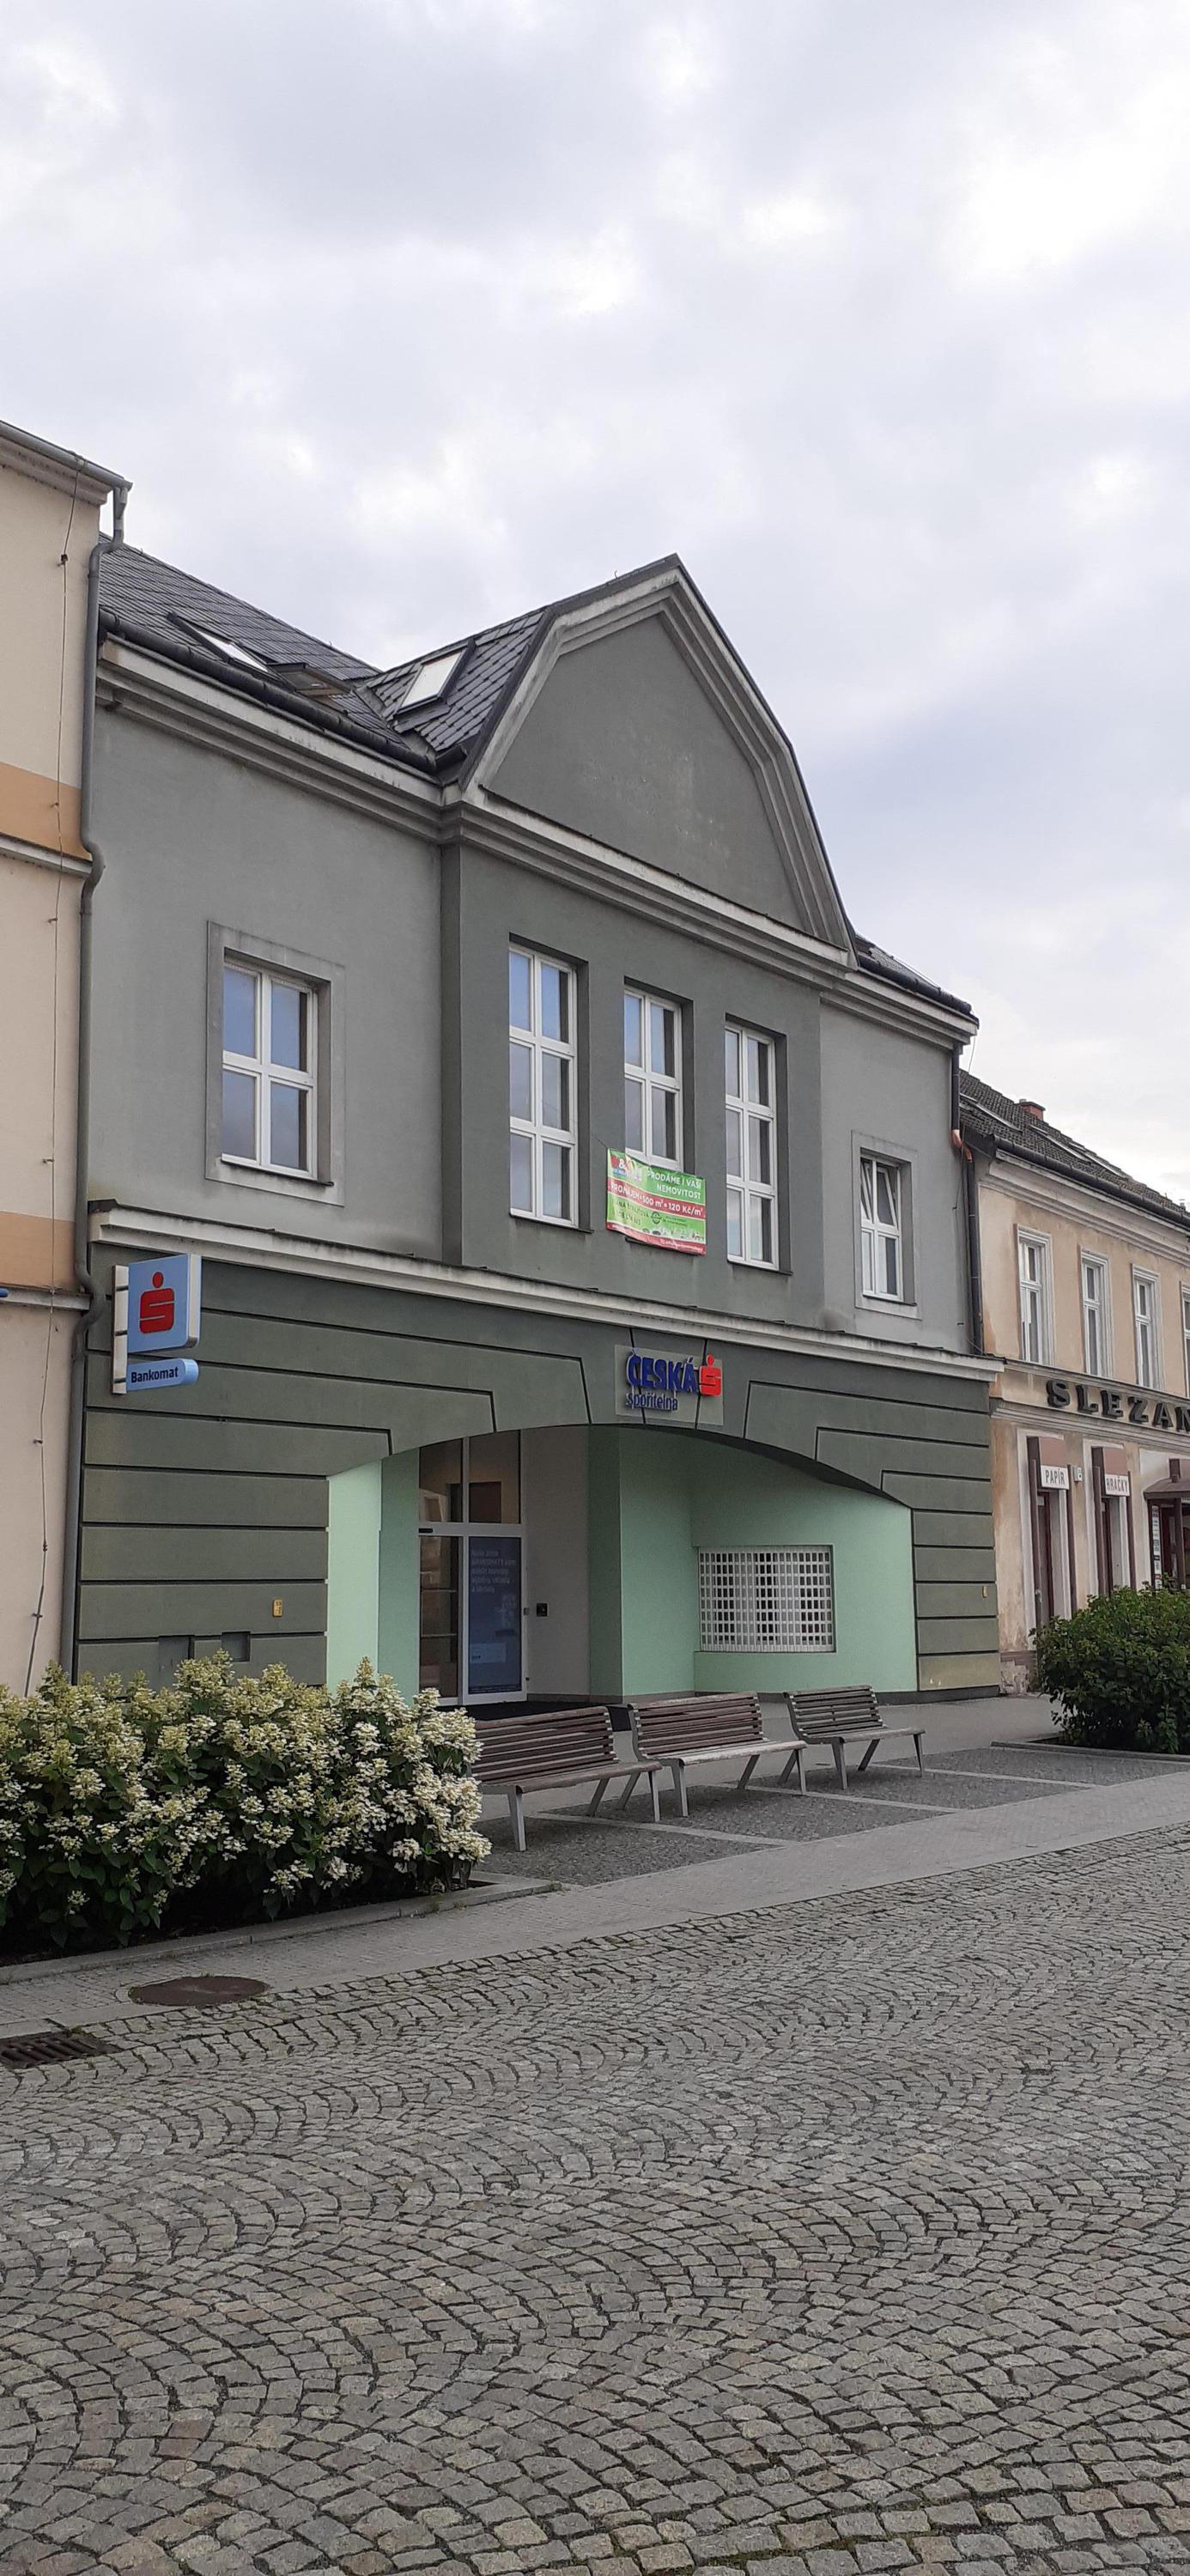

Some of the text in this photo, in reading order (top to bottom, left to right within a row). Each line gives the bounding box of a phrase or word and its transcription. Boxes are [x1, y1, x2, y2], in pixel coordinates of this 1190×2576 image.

[657, 1183, 701, 1200] NEMOVITOST
[668, 1202, 681, 1212] 120
[131, 1366, 179, 1383] Bankomat
[627, 1348, 699, 1394] ČESKÁ
[626, 1391, 678, 1411] spořitelna
[1045, 1467, 1066, 1485] PAPÍR
[1106, 1476, 1128, 1493] HRAČKY
